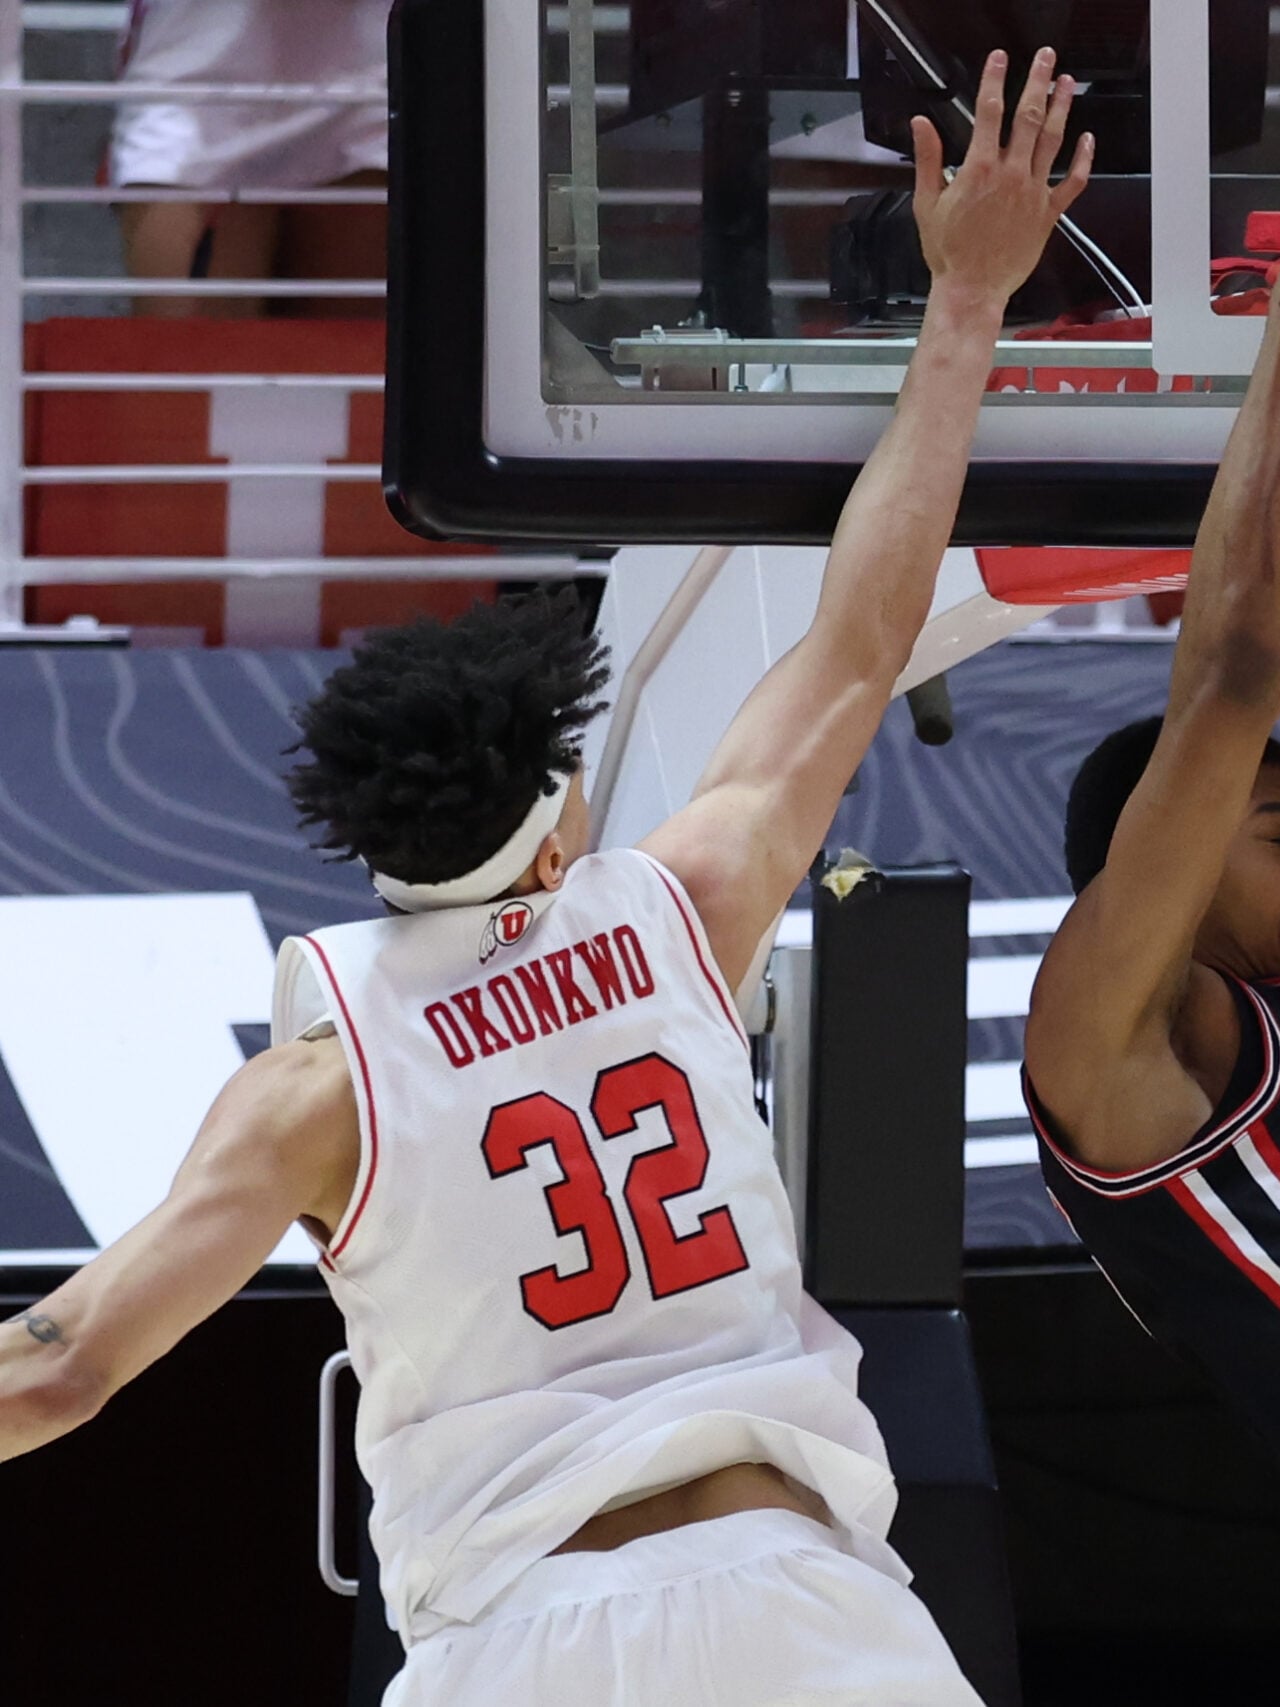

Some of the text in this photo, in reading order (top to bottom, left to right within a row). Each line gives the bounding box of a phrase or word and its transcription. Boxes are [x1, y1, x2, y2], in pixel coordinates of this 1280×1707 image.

[424, 924, 655, 1069] OKONKWO
[501, 909, 527, 942] U
[481, 1051, 750, 1331] 32
